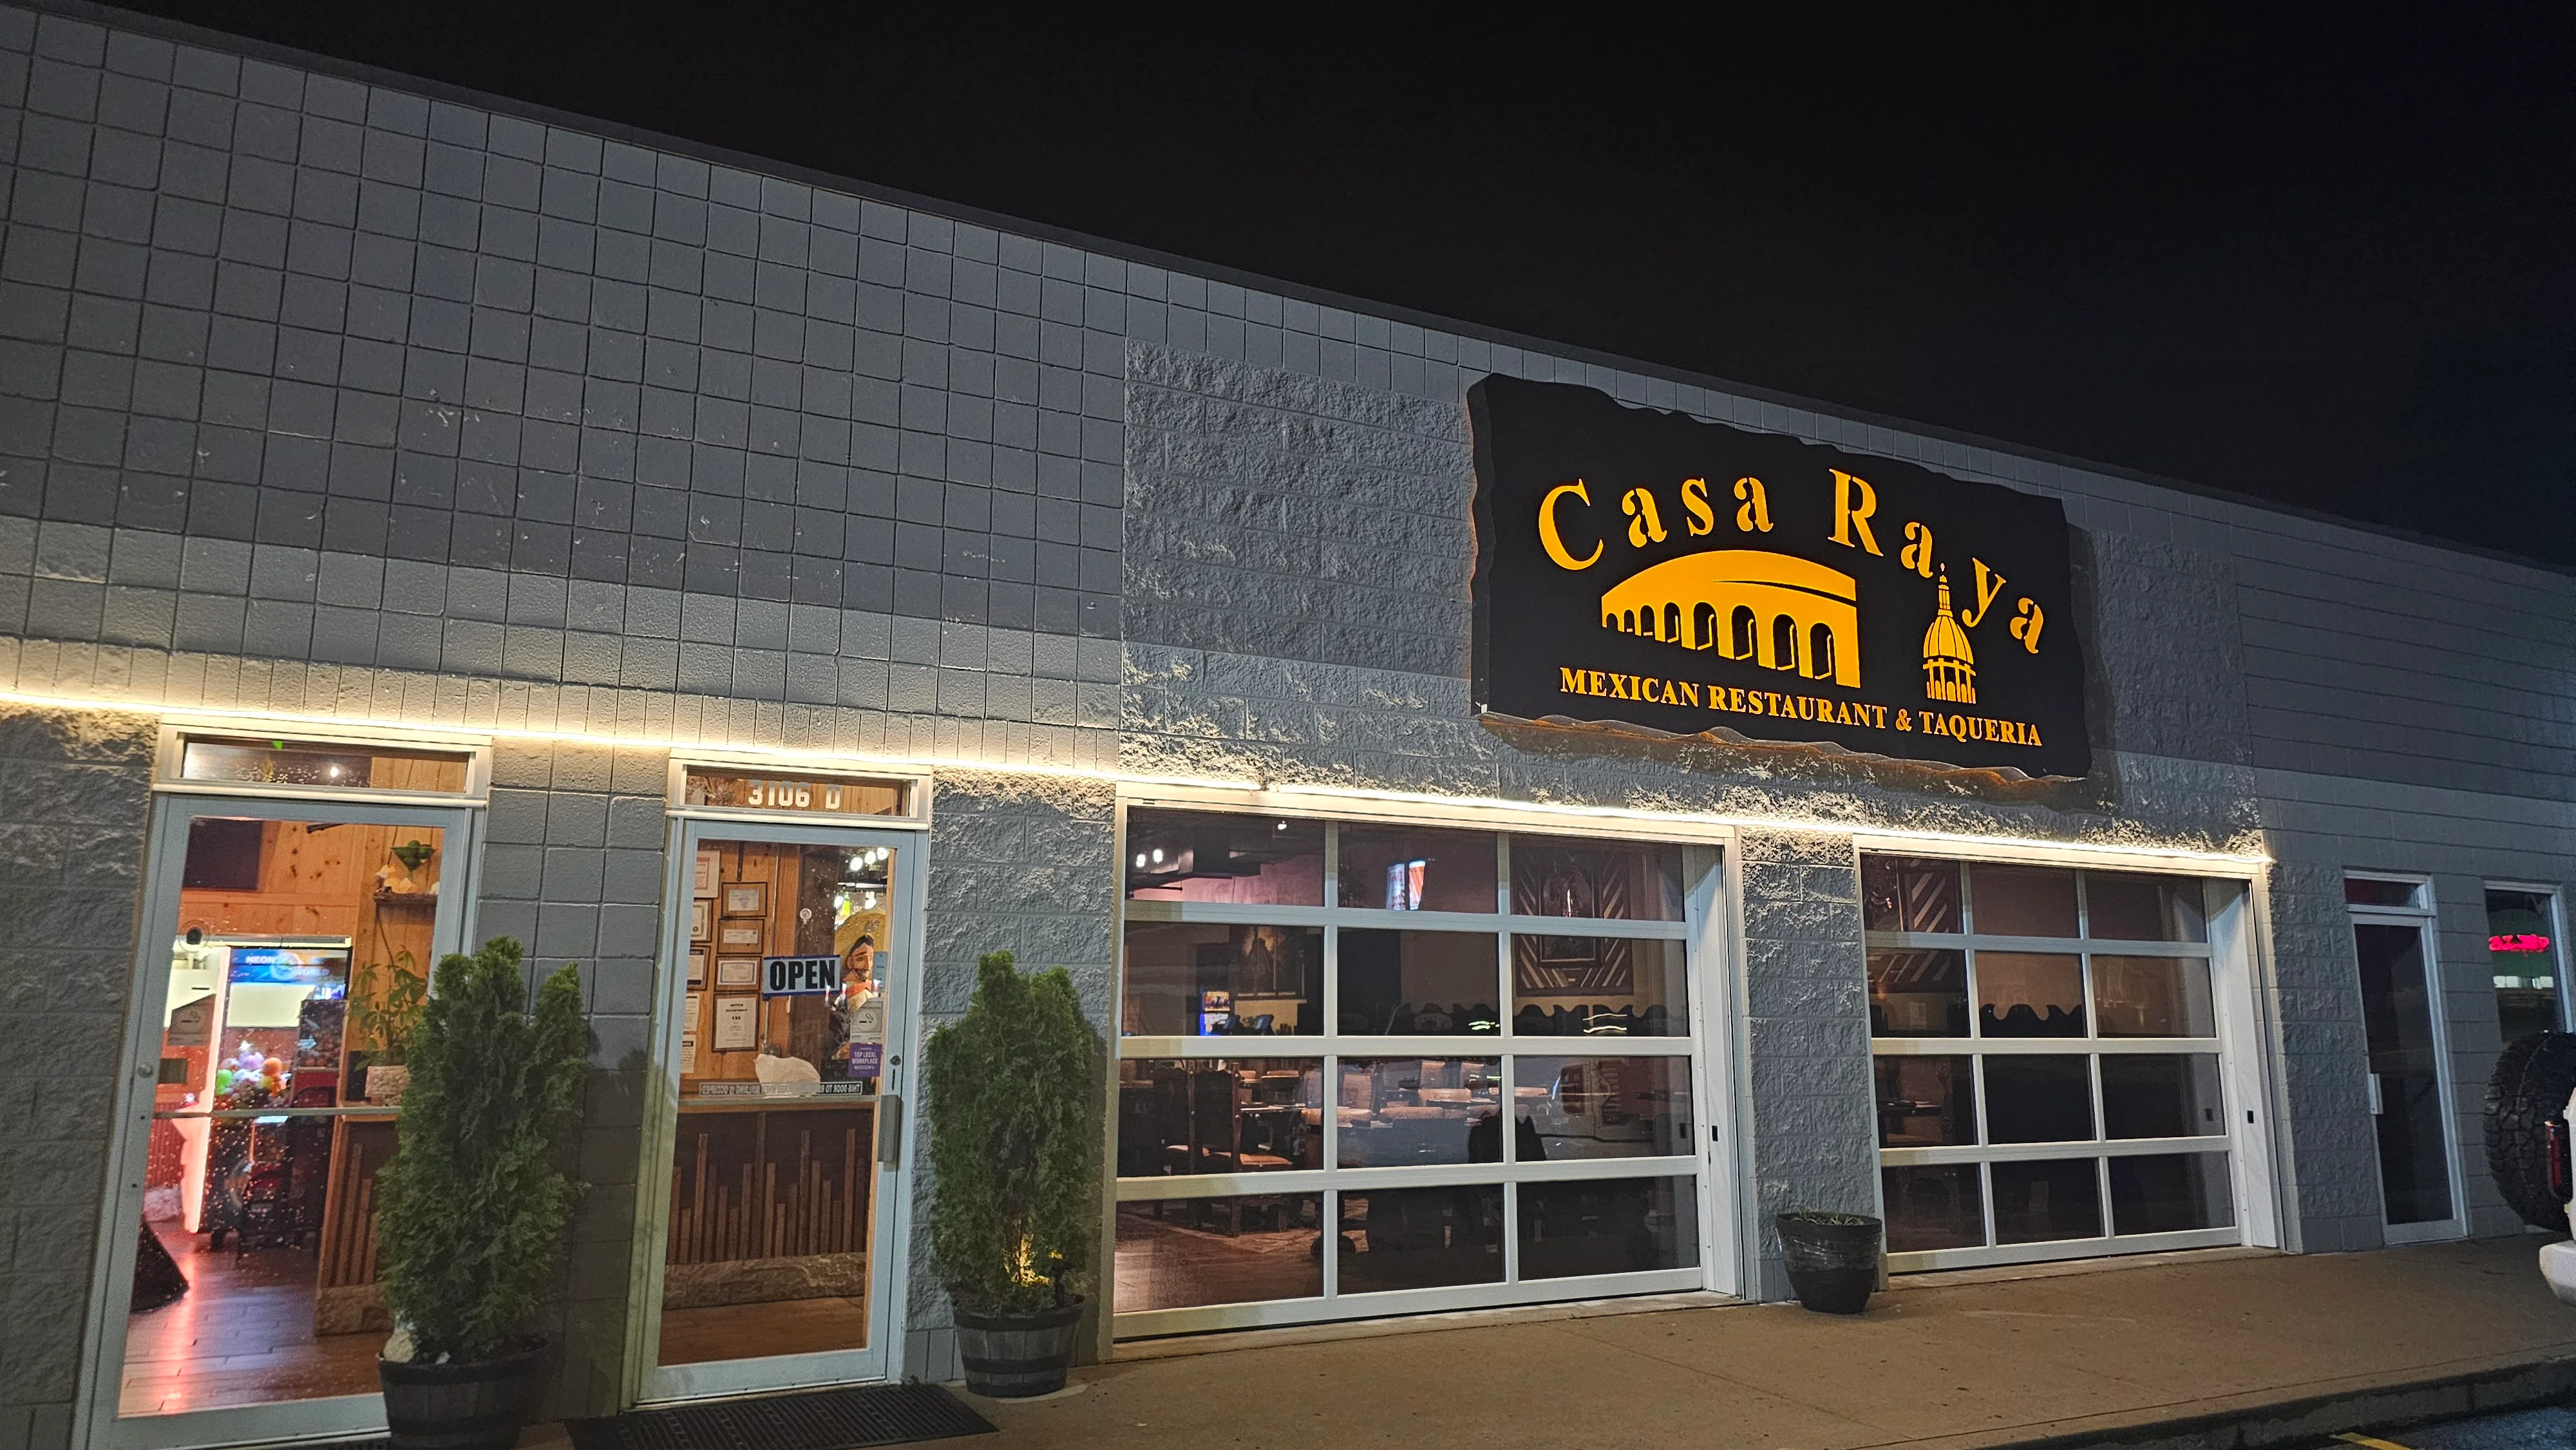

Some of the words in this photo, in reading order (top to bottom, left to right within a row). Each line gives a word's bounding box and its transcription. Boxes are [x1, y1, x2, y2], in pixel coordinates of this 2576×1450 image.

[1538, 478, 1774, 570] Casa
[1827, 468, 2045, 654] Raya
[1560, 667, 1699, 707] MEXICAN
[1708, 684, 1887, 730] RESTAURANT
[1895, 709, 1912, 731] &
[1918, 711, 2042, 746] TAQUERIA
[748, 779, 811, 807] 3106
[770, 959, 835, 991] OPEN
